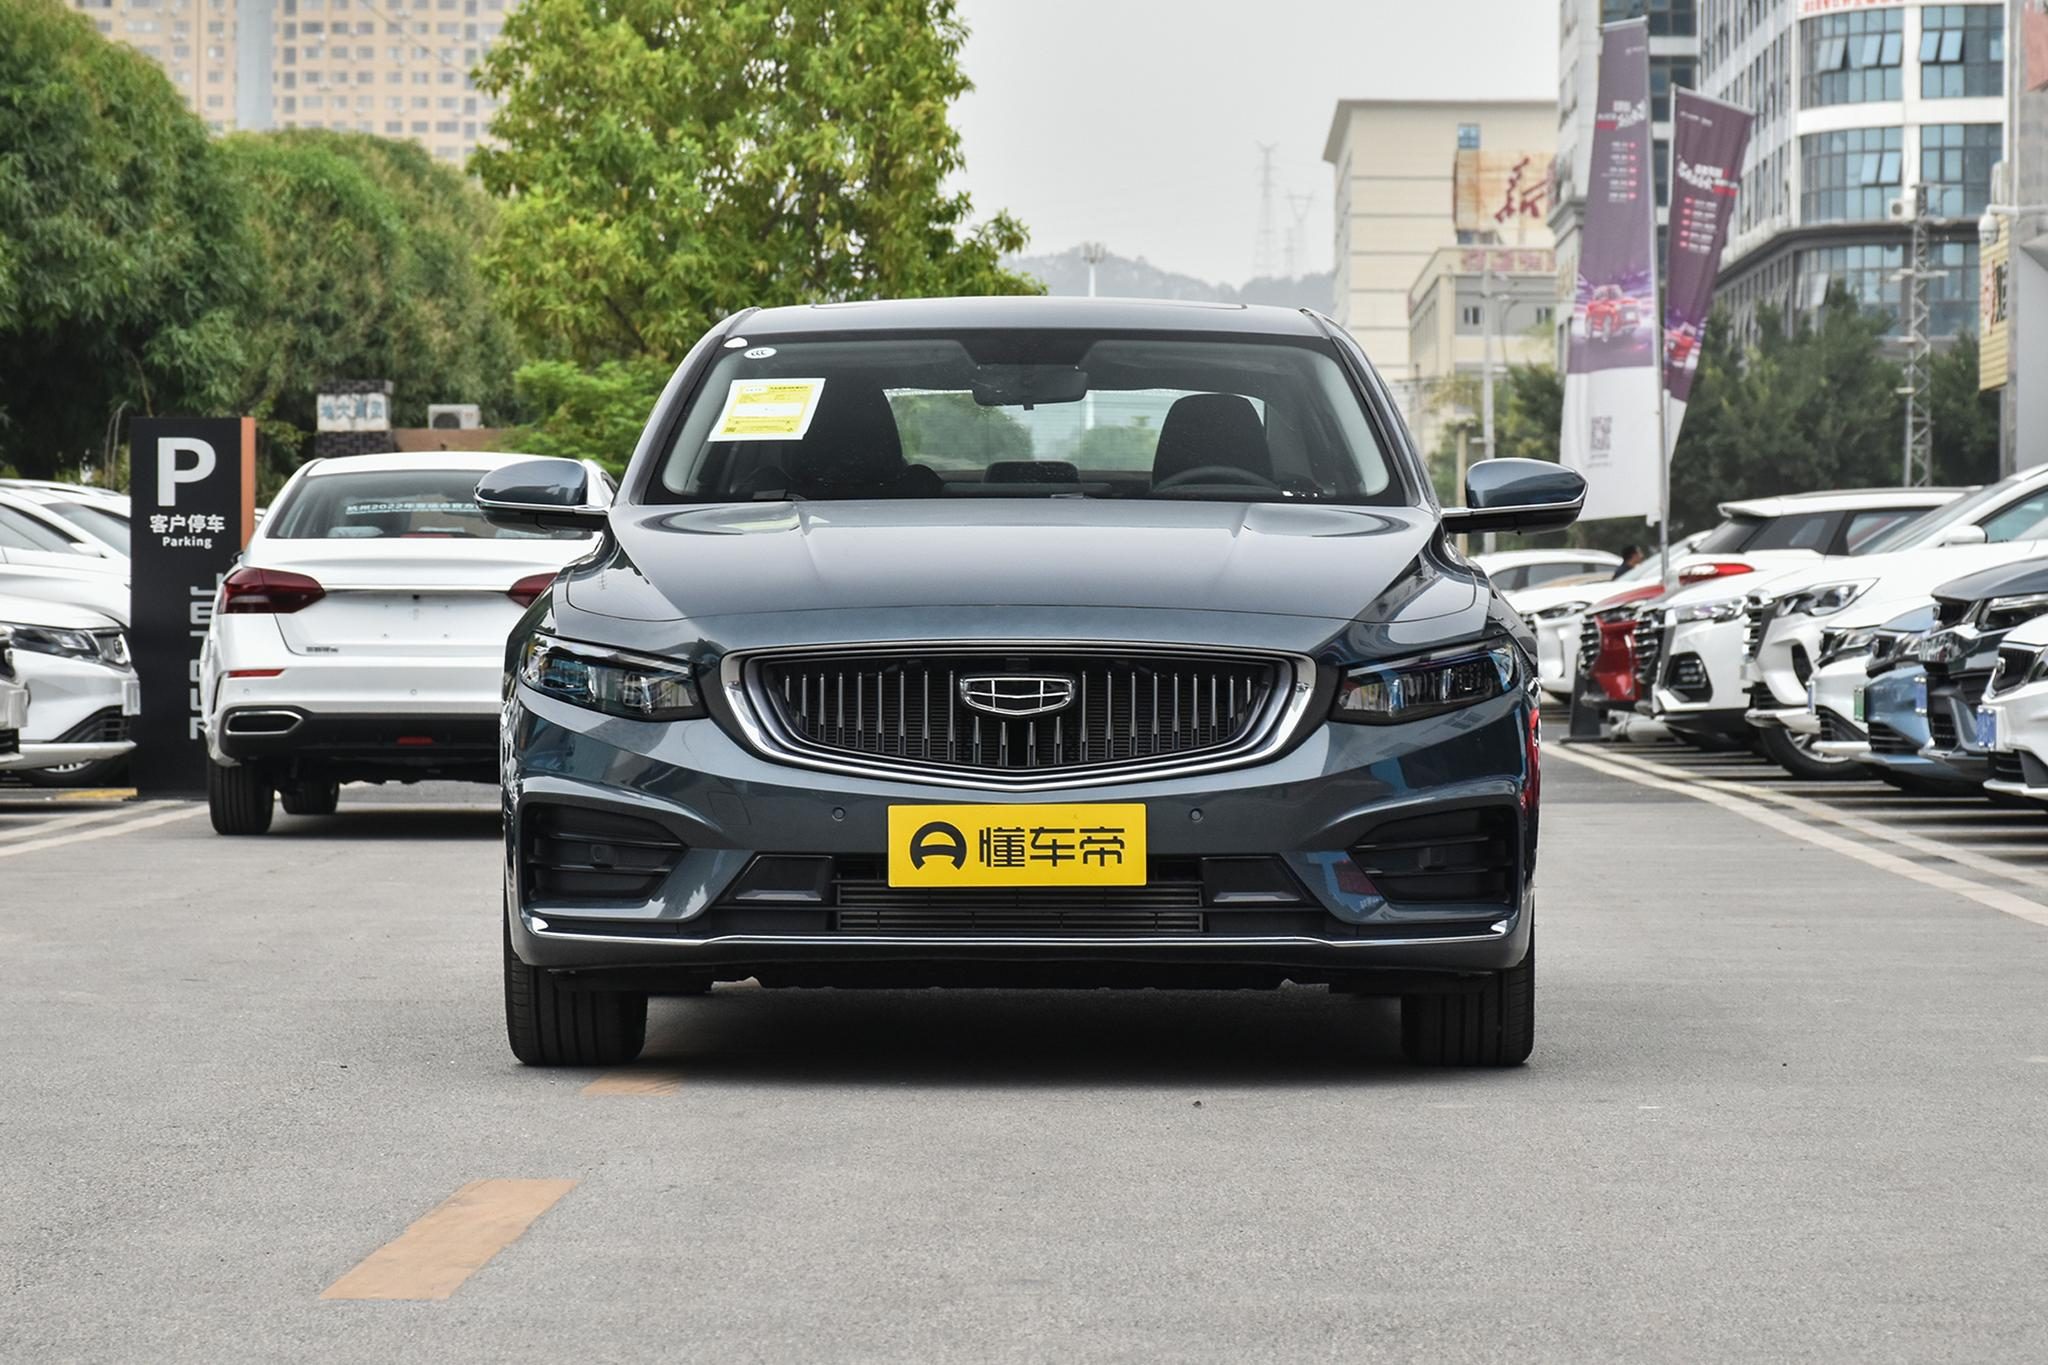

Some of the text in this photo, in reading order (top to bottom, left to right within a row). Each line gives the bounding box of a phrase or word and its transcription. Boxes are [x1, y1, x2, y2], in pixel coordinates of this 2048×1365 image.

[157, 437, 217, 507] P
[149, 513, 226, 534] 客户停车
[162, 535, 213, 550] Parking
[978, 826, 1126, 868] 懂车帝
